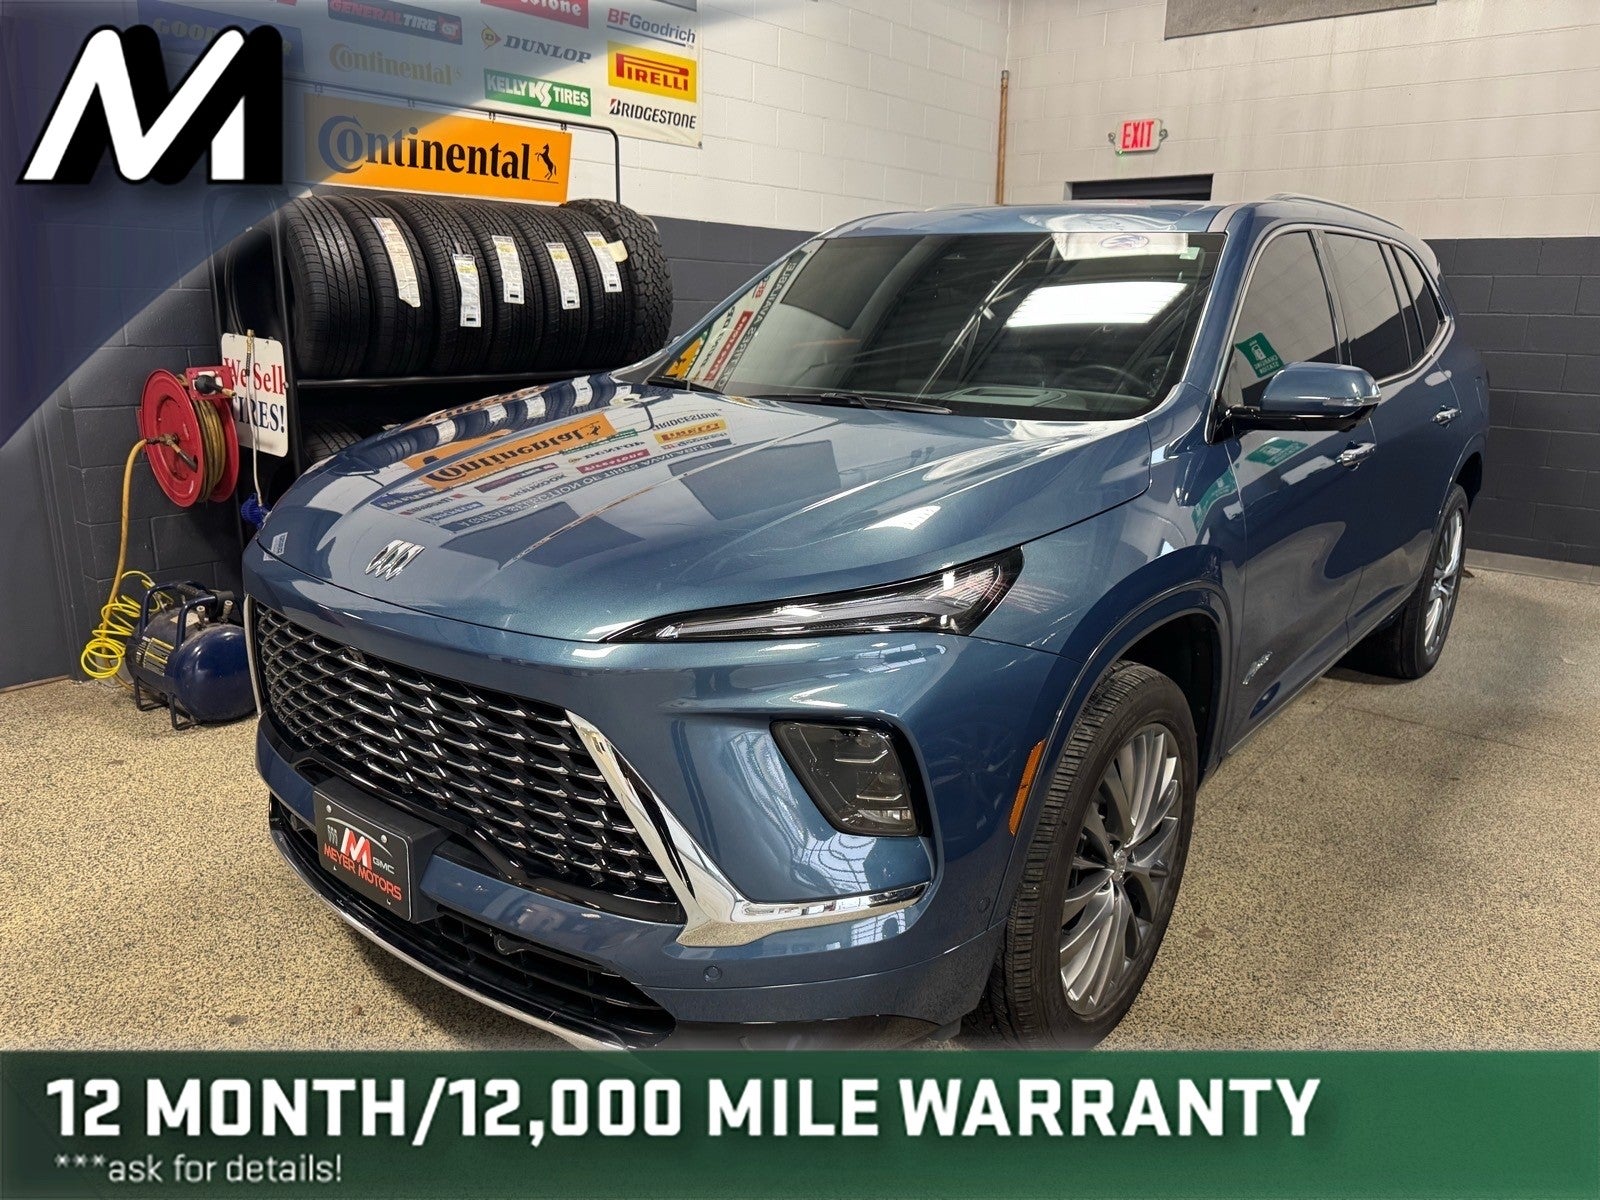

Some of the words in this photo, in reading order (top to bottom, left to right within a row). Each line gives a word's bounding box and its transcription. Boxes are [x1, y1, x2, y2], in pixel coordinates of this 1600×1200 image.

[403, 13, 437, 32] TIRE
[607, 8, 696, 43] BFGoodrich
[328, 43, 453, 86] Continental
[503, 35, 591, 63] DUNLOP
[615, 53, 690, 91] PIRELLI
[486, 74, 527, 96] KELLY
[552, 86, 590, 107] TIRES
[609, 98, 697, 129] BRIDGESTONE
[317, 114, 531, 181] Continental
[1121, 120, 1155, 149] EXIT
[253, 362, 285, 395] Sell
[232, 396, 285, 434] IRES!
[323, 842, 356, 875] MEYER
[358, 865, 402, 901] MOTORS
[372, 856, 395, 875] GMC
